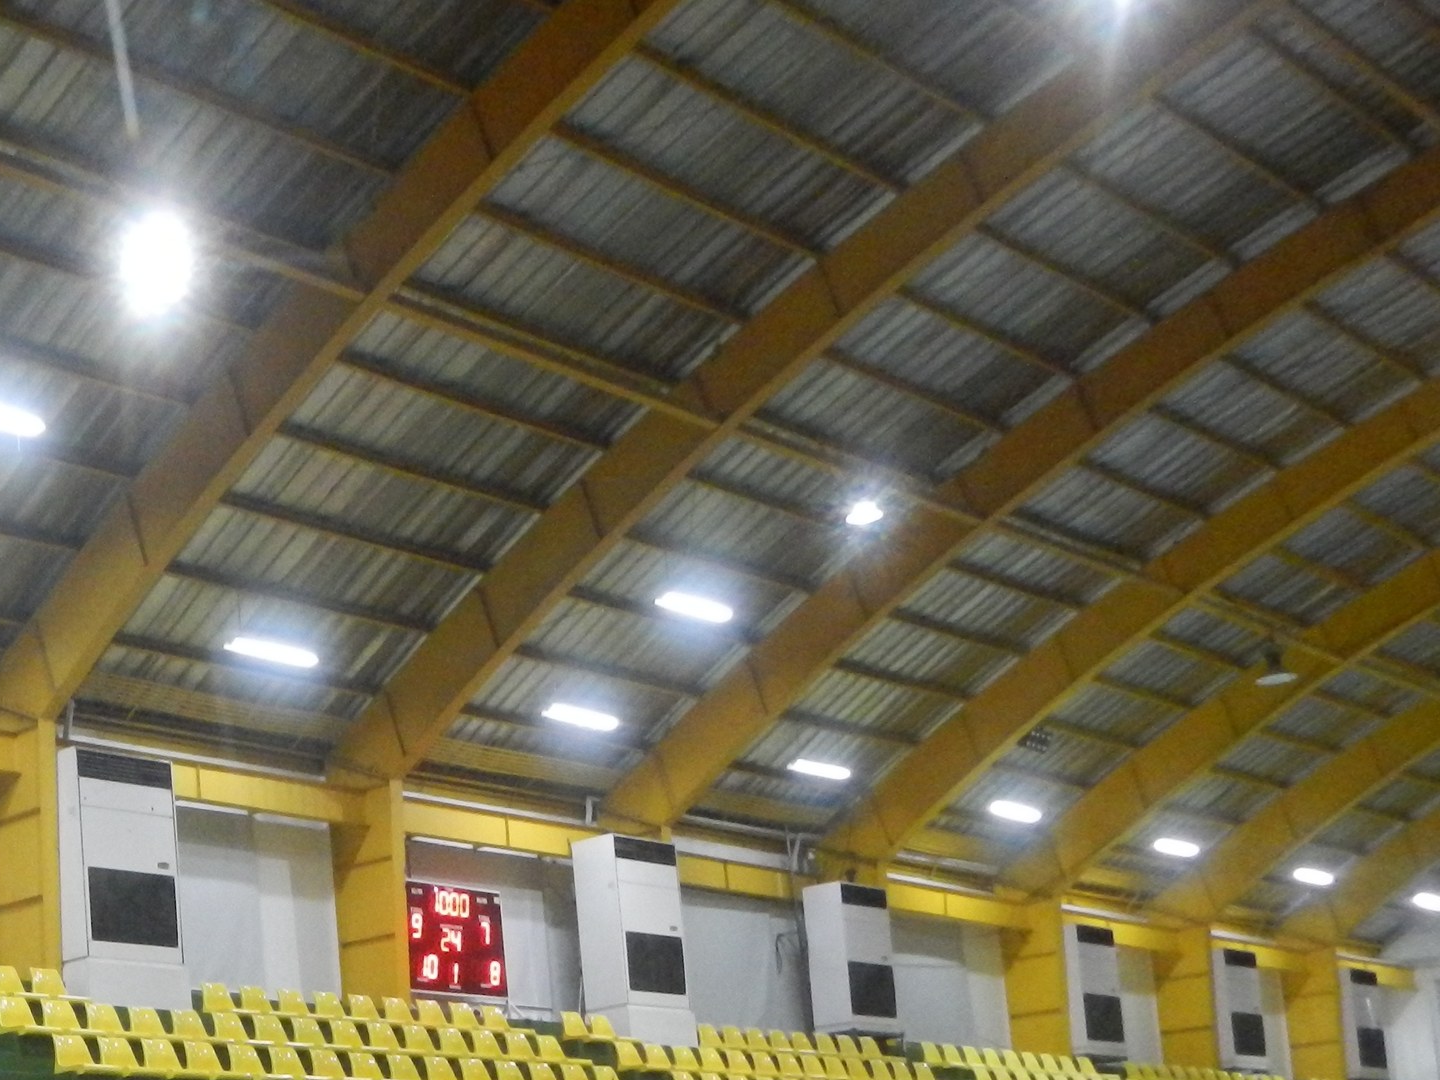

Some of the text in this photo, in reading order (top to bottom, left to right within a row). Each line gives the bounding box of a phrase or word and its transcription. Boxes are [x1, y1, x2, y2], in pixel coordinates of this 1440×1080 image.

[411, 914, 422, 938] 9
[480, 921, 491, 945] 7
[440, 928, 462, 952] 24
[453, 962, 459, 985] 1
[489, 960, 501, 986] 8
